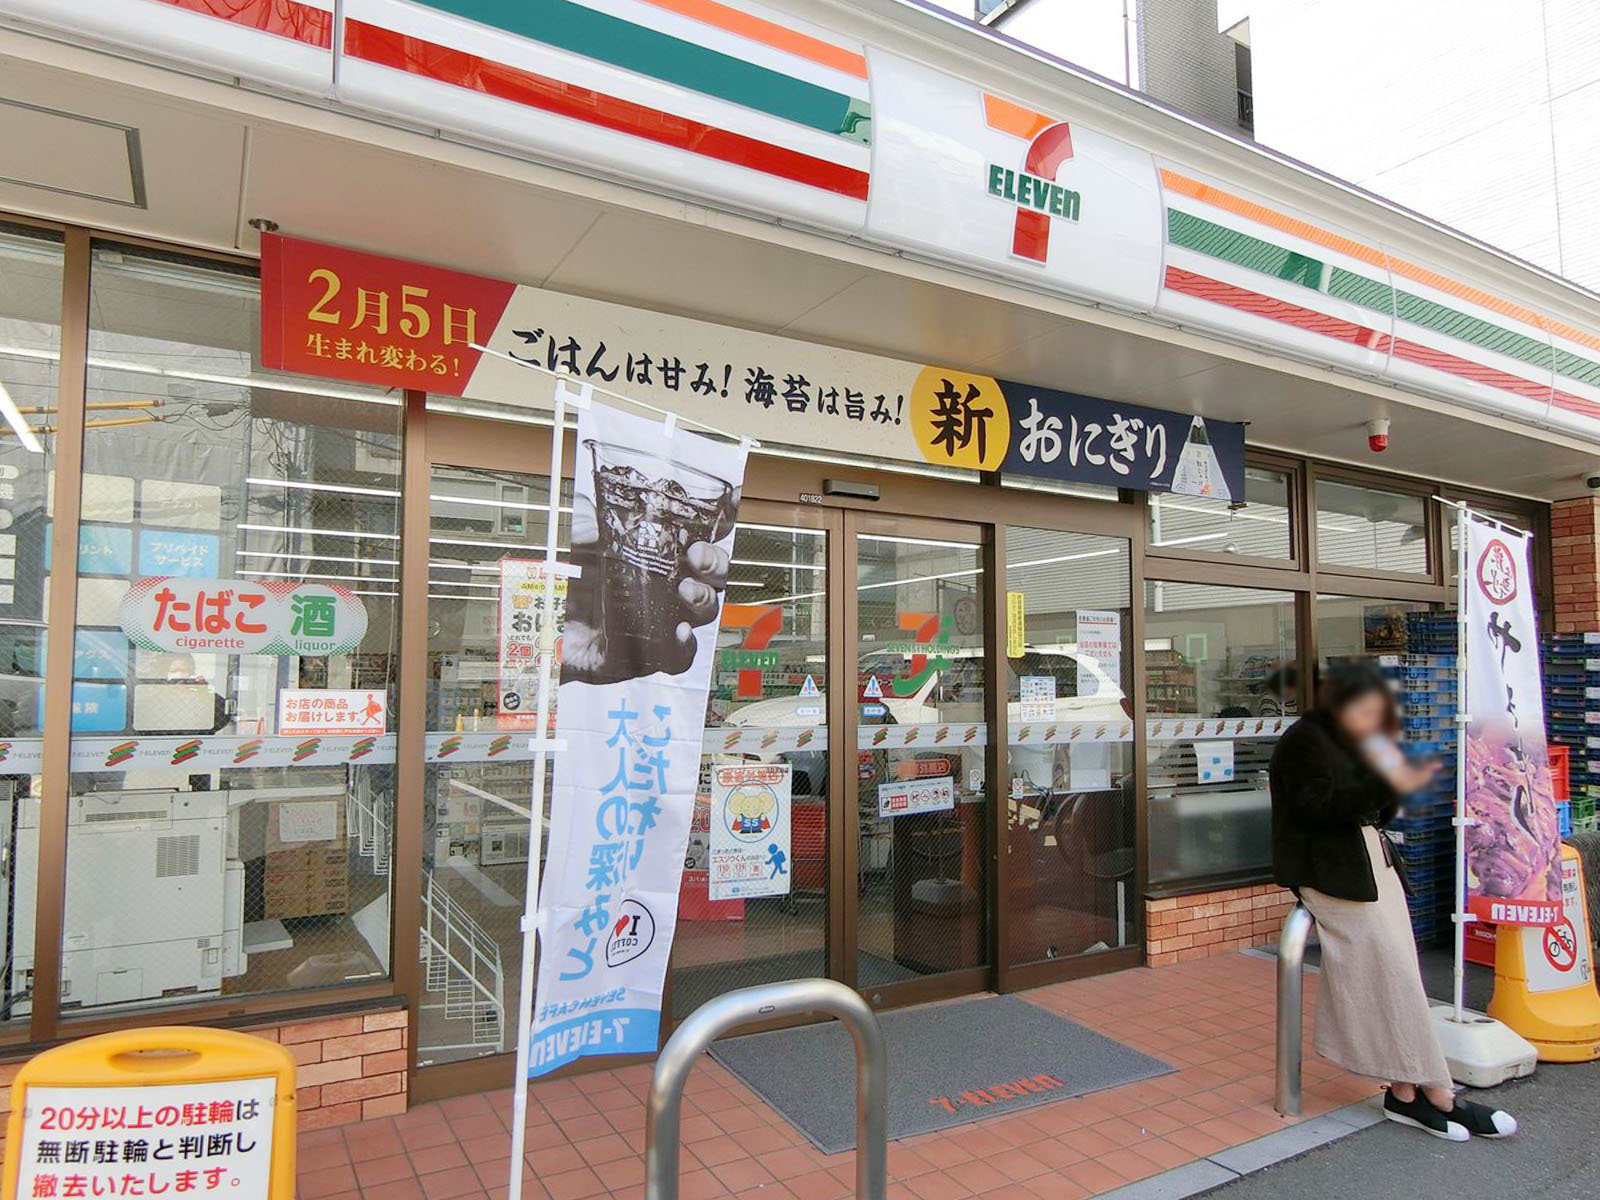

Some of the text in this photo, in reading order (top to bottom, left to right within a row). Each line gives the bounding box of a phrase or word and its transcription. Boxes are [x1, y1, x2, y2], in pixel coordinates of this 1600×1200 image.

[307, 268, 477, 346] 2月5日
[305, 333, 460, 378] 生まれ変わる!
[929, 378, 994, 465] 新
[1018, 399, 1167, 479] おにぎり
[153, 588, 337, 637] たばこ 酒
[175, 636, 336, 653] cigarette liquor
[285, 698, 349, 710] お店の商品
[39, 1098, 260, 1131] 20分以上の駐輪は
[36, 1131, 257, 1164] 無断駐輪と判断し
[32, 1166, 241, 1199] 撤去いたします。
